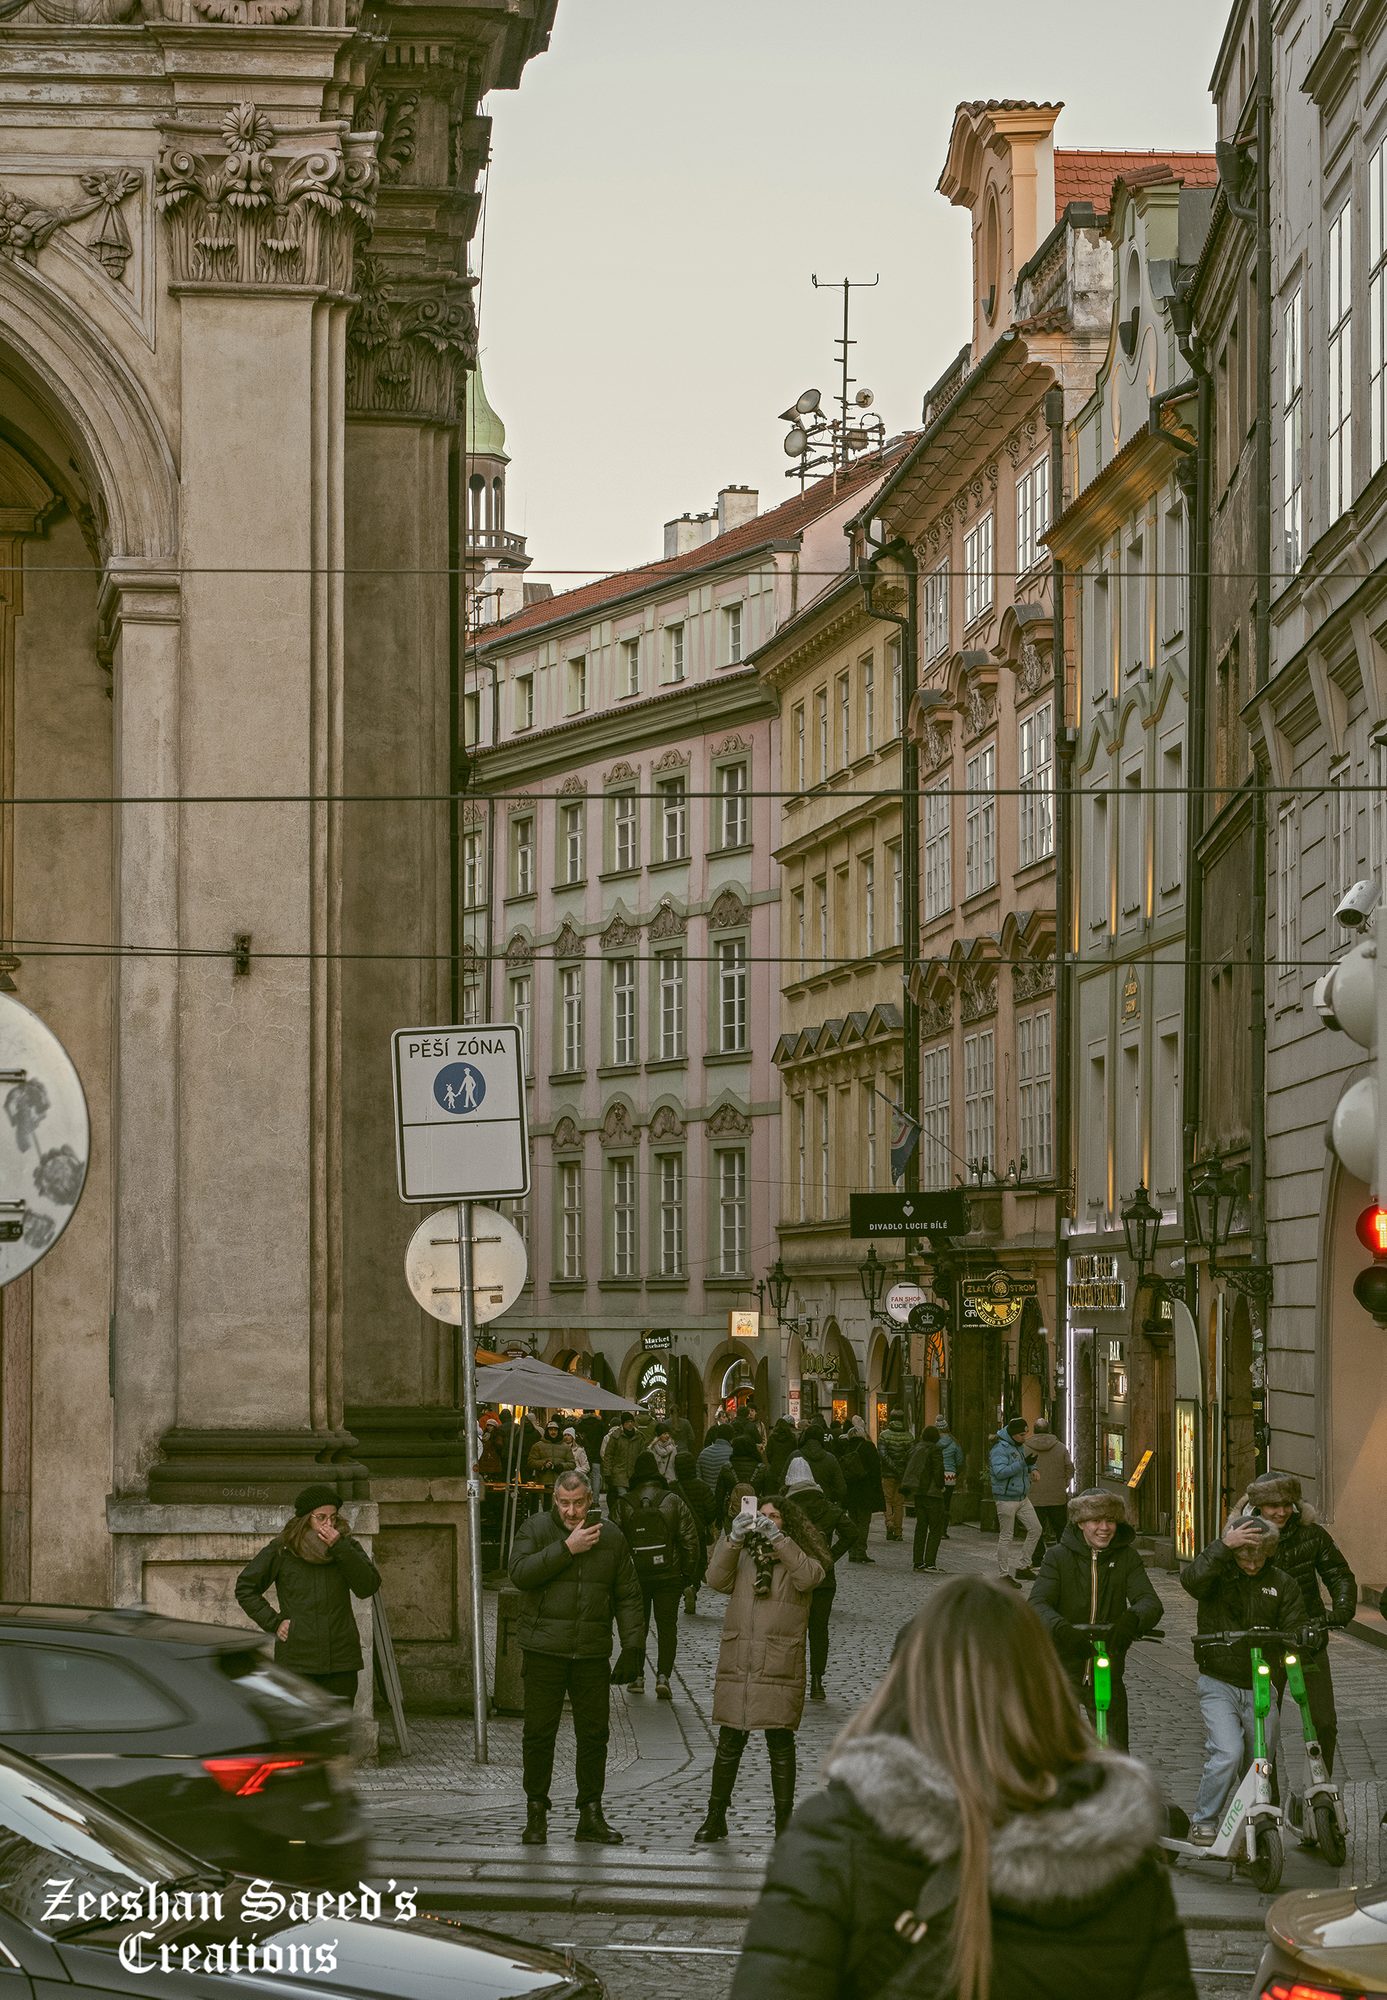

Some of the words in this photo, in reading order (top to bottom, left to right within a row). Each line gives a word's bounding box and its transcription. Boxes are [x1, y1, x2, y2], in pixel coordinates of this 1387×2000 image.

[409, 1038, 450, 1058] PĚŠÍ
[457, 1036, 506, 1056] ZÓNA
[869, 1223, 903, 1231] DIVADLO
[905, 1222, 928, 1230] LUCIE
[930, 1220, 948, 1229] BÍLÉ
[966, 1284, 992, 1293] ZLATÝ
[1009, 1284, 1036, 1293] STROM
[645, 1336, 670, 1344] Market
